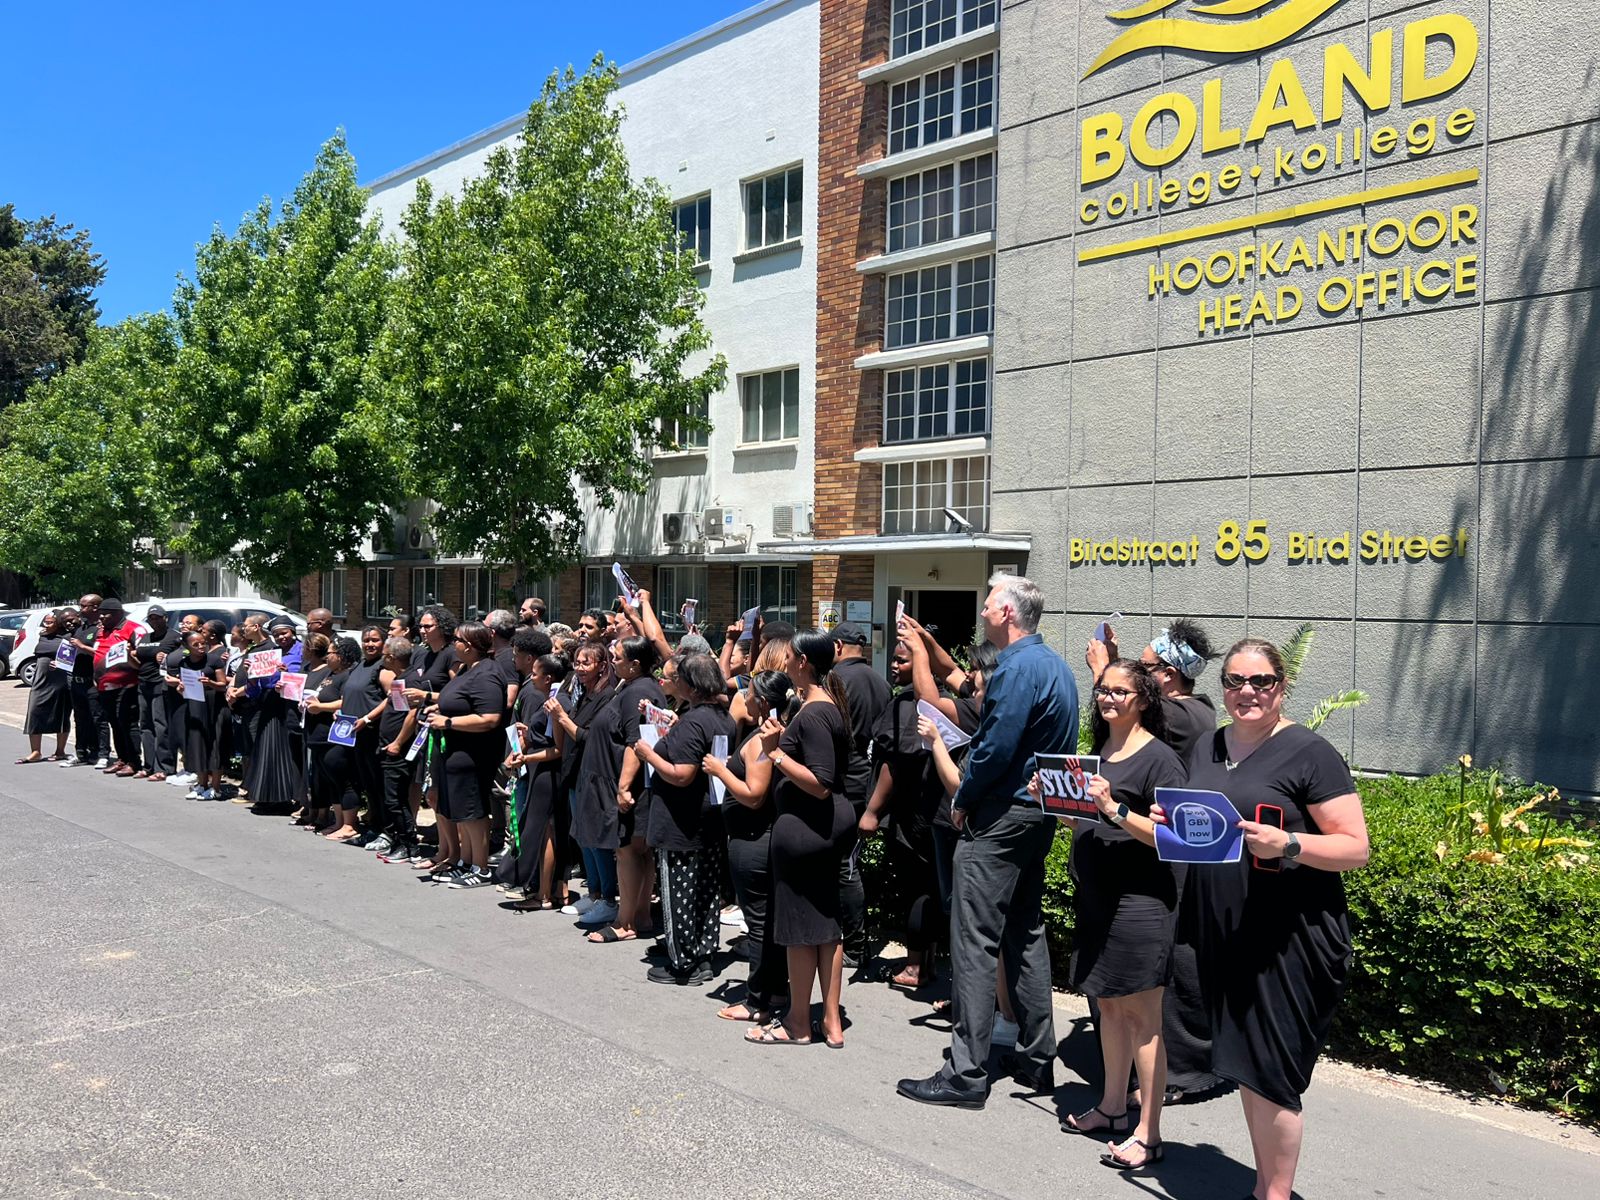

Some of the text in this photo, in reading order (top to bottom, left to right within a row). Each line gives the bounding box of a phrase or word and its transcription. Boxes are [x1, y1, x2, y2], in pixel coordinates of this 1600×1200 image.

[1081, 13, 1479, 186] BOLAND
[1148, 204, 1479, 295] HOOFKANTOOR
[1199, 255, 1478, 332] HEAD OFFICE
[1069, 519, 1469, 562] Birdstraat 85 Bird Street
[253, 651, 275, 663] STOP
[1188, 818, 1209, 826] GBV
